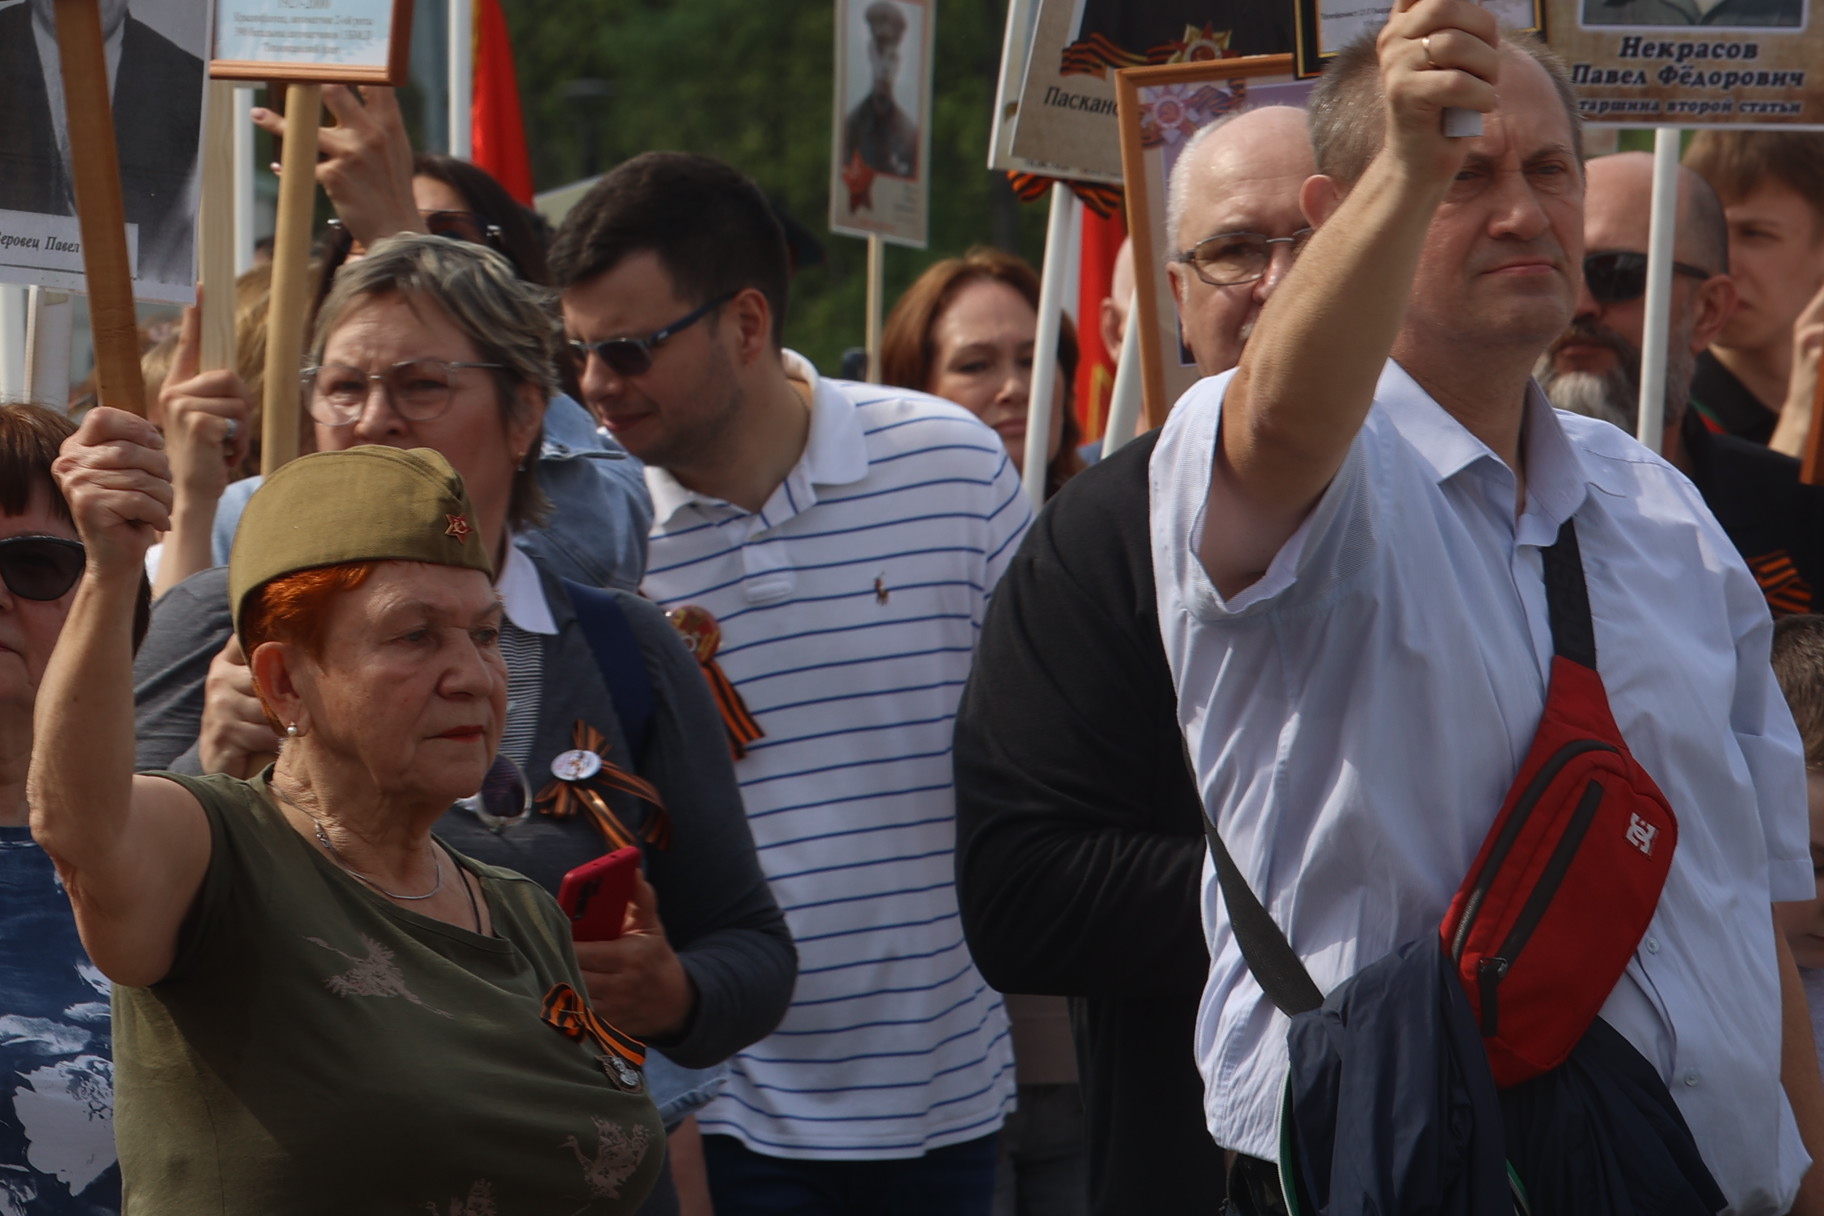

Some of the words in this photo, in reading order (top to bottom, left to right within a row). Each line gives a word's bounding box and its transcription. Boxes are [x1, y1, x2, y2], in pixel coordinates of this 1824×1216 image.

[1618, 36, 1759, 63] Некрасов
[1571, 63, 1648, 86] Павел
[1657, 64, 1806, 90] Фёдорович
[1577, 99, 1660, 115] таршина
[1666, 96, 1733, 115] второй
[1738, 98, 1802, 113] статьи
[45, 235, 81, 254] Павел
